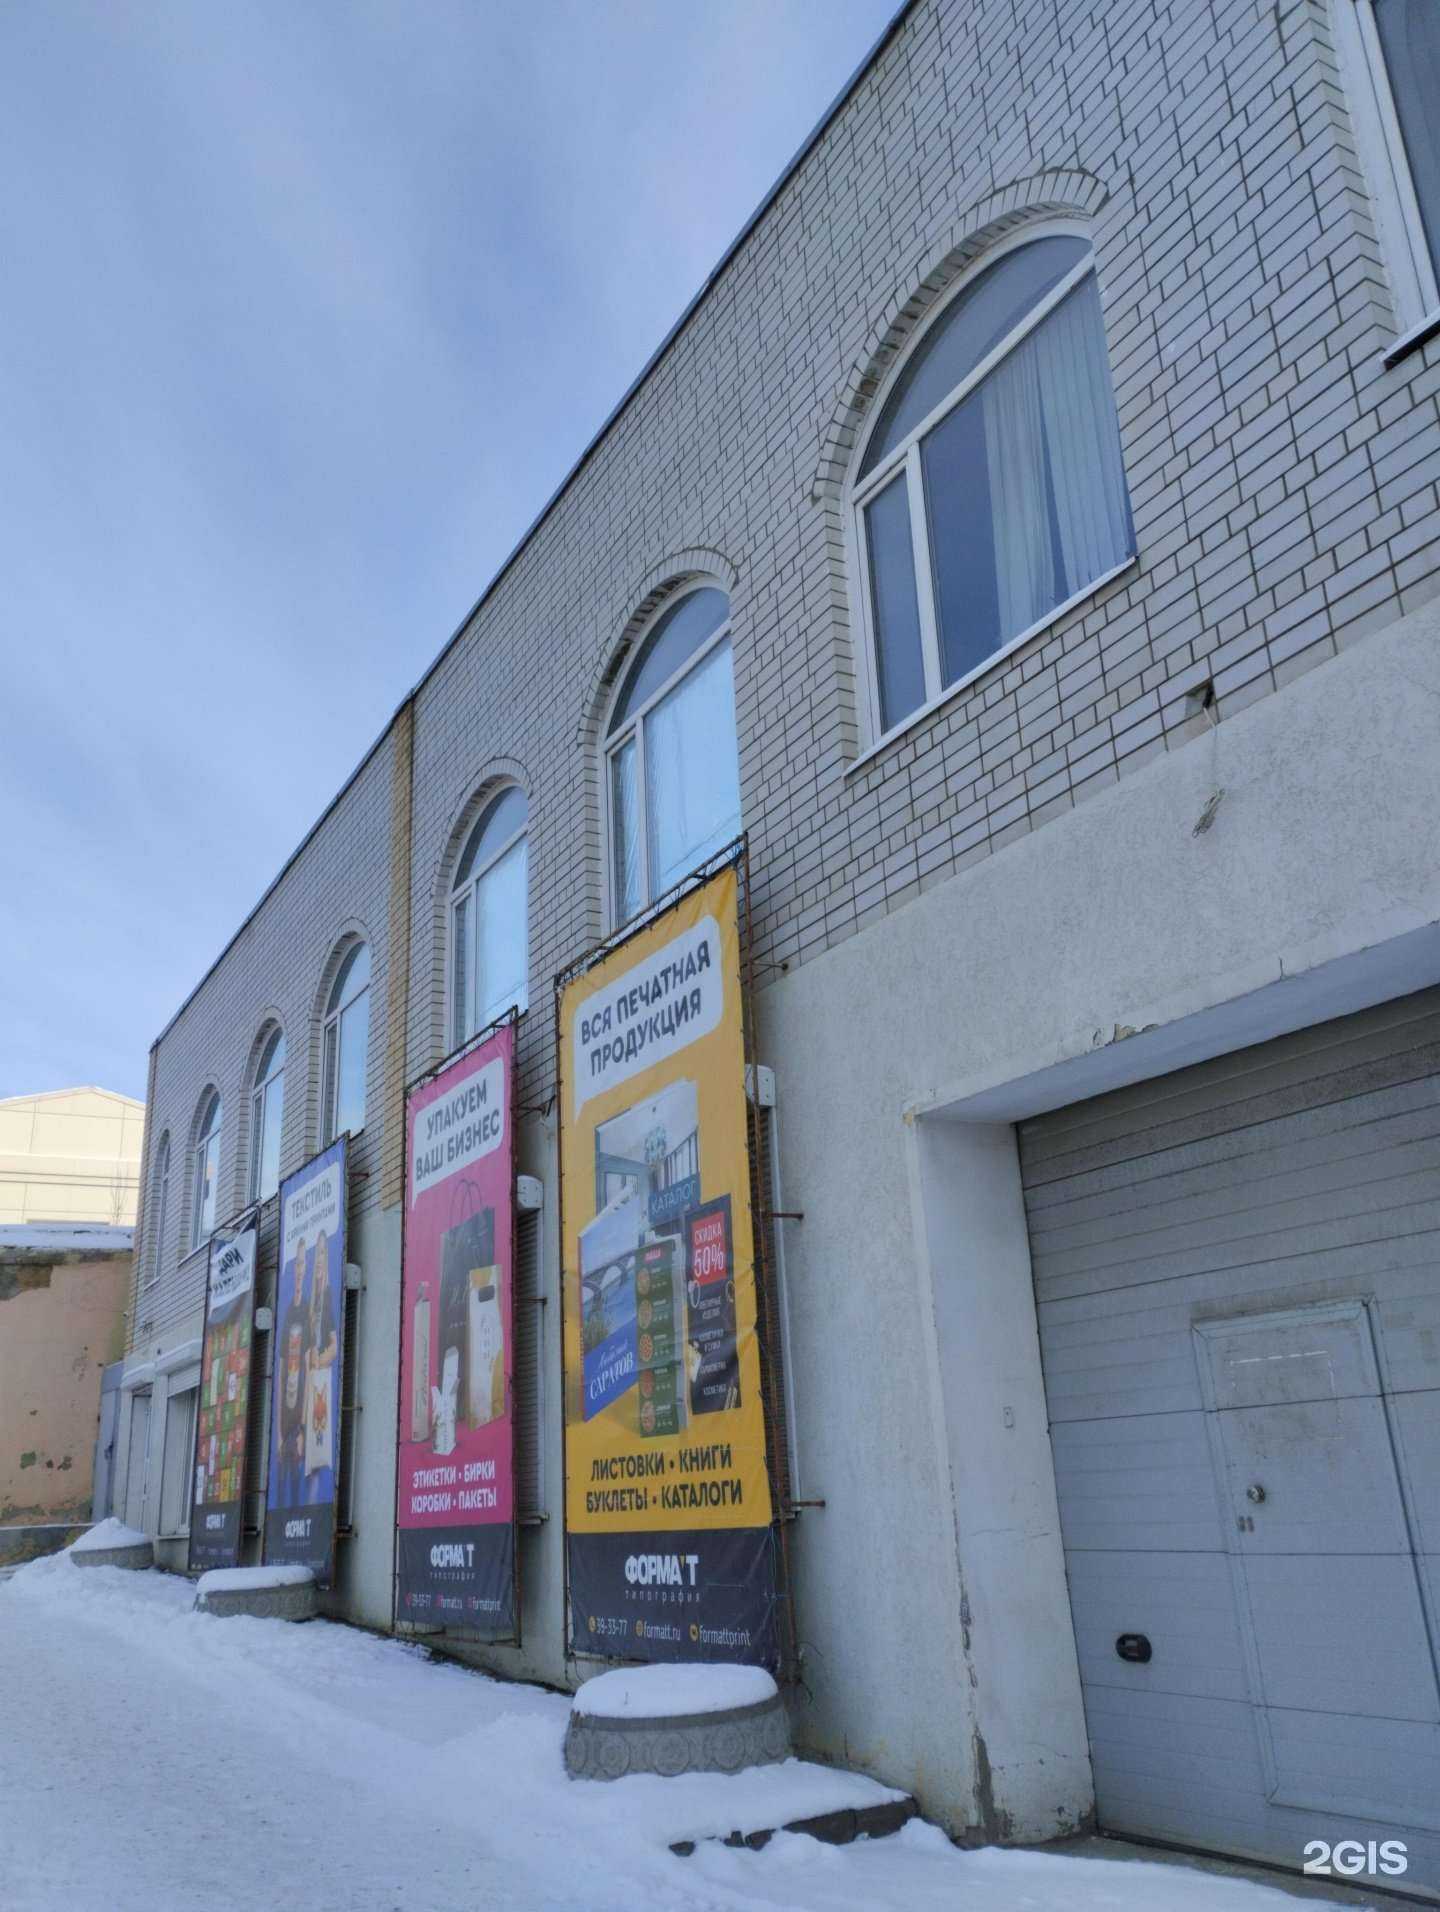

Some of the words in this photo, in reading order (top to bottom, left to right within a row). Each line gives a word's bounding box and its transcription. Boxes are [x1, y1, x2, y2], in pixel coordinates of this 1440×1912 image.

[581, 1005, 613, 1046] ВСЯ
[616, 939, 711, 1029] ПЕЧАТНАЯ
[590, 987, 702, 1077] ПРОДУКЦИЯ
[426, 1079, 487, 1140] УПАКУЕМ
[415, 1143, 444, 1181] ВАШ
[447, 1108, 500, 1163] БИЗНЕС
[694, 1221, 723, 1245] СКИДКА
[694, 1245, 725, 1278] 50%
[412, 1466, 457, 1489] ЭТИКЕТКИ
[463, 1460, 496, 1482] БИРКИ
[590, 1451, 665, 1482] ЛИСТОВКИ
[678, 1443, 732, 1474] КНИГИ
[411, 1492, 452, 1514] КОРОБКИ
[458, 1486, 497, 1510] ПАКЕТЫ
[586, 1487, 648, 1513] БУКЛЕТЫ
[661, 1478, 743, 1509] КАТАЛОГИ
[643, 1618, 681, 1642] formatt.ru
[699, 1624, 751, 1649] formattprint
